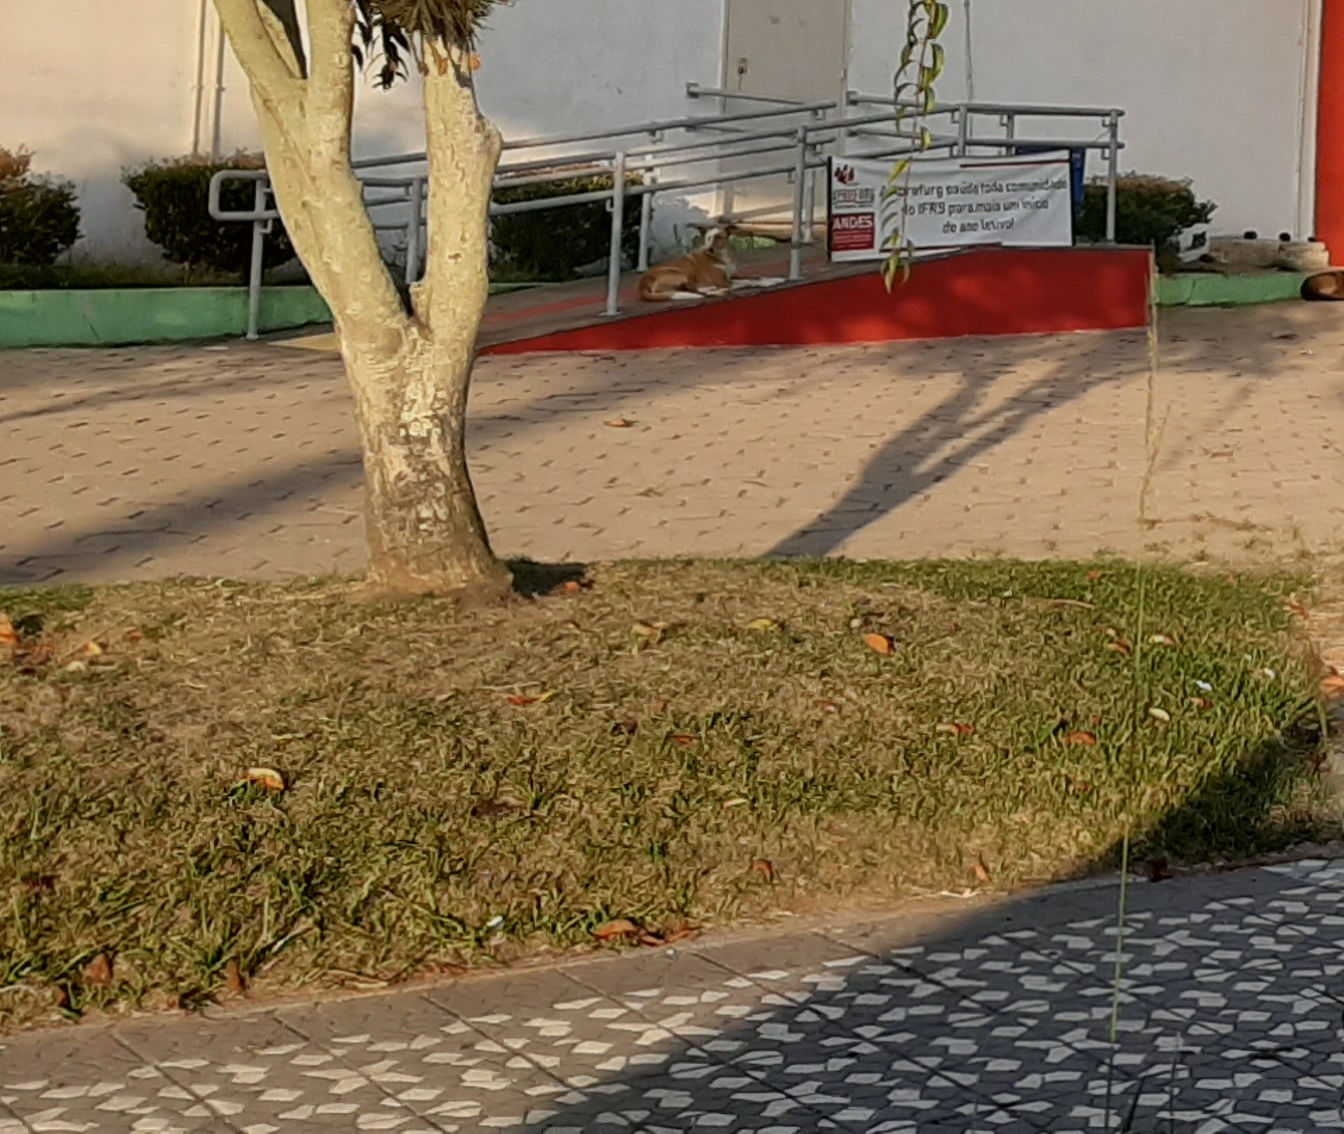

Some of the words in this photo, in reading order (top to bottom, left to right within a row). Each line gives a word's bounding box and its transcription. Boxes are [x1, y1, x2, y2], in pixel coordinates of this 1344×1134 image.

[981, 180, 1003, 193] toda
[918, 202, 945, 215] IFRS
[948, 203, 974, 216] para
[976, 201, 1000, 212] mais
[1003, 202, 1019, 211] um
[943, 220, 957, 234] do
[960, 221, 979, 233] ano
